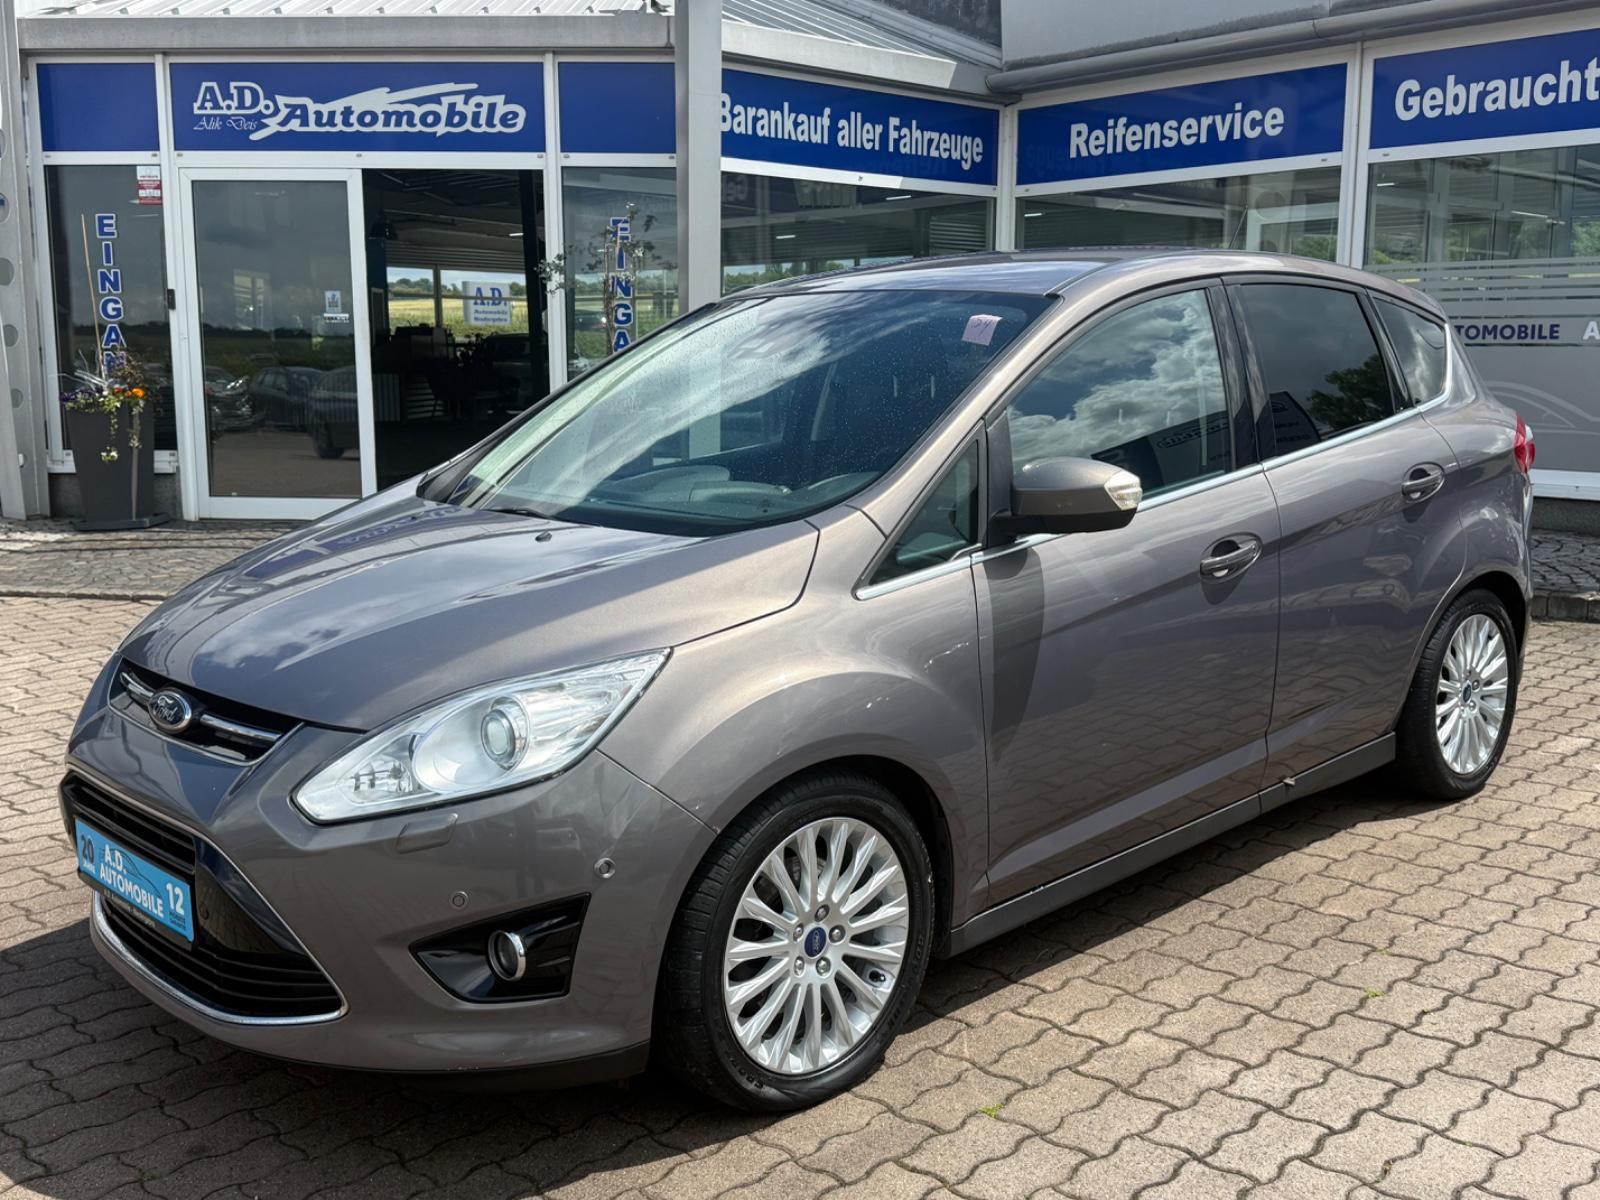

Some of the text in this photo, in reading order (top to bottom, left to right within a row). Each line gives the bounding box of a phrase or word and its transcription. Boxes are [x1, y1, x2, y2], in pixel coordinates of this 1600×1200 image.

[193, 82, 524, 133] A.D. Automobile
[1395, 60, 1600, 122] Gebraucht
[720, 92, 984, 170] Barankauf aller Fahrzeuge
[1068, 101, 1285, 159] Reifenservice
[104, 844, 128, 874] A.D.
[100, 863, 164, 918] AUTOMOBILE
[166, 882, 185, 915] 12
